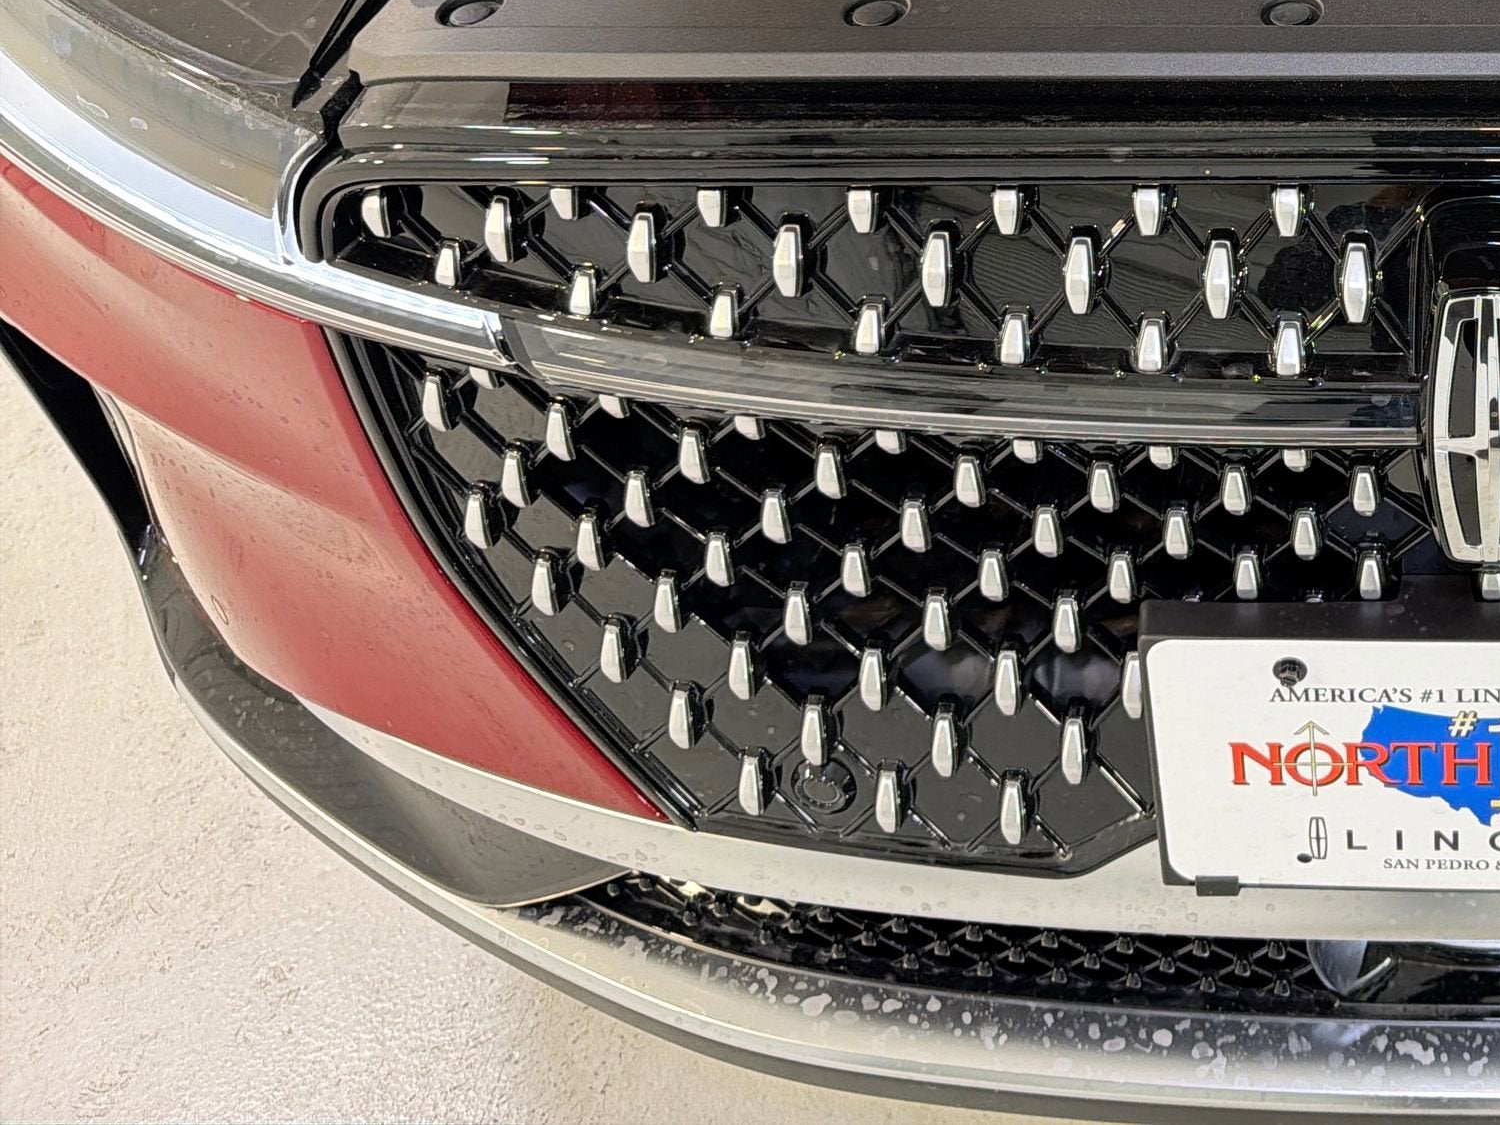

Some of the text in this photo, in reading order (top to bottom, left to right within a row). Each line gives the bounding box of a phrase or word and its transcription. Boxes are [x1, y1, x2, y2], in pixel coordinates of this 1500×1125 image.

[1269, 687, 1413, 704] AMERICA'S
[1419, 687, 1447, 704] #1
[1227, 741, 1493, 787] NORTH
[1382, 857, 1421, 870] SAN
[1425, 858, 1490, 871] PEDRO
